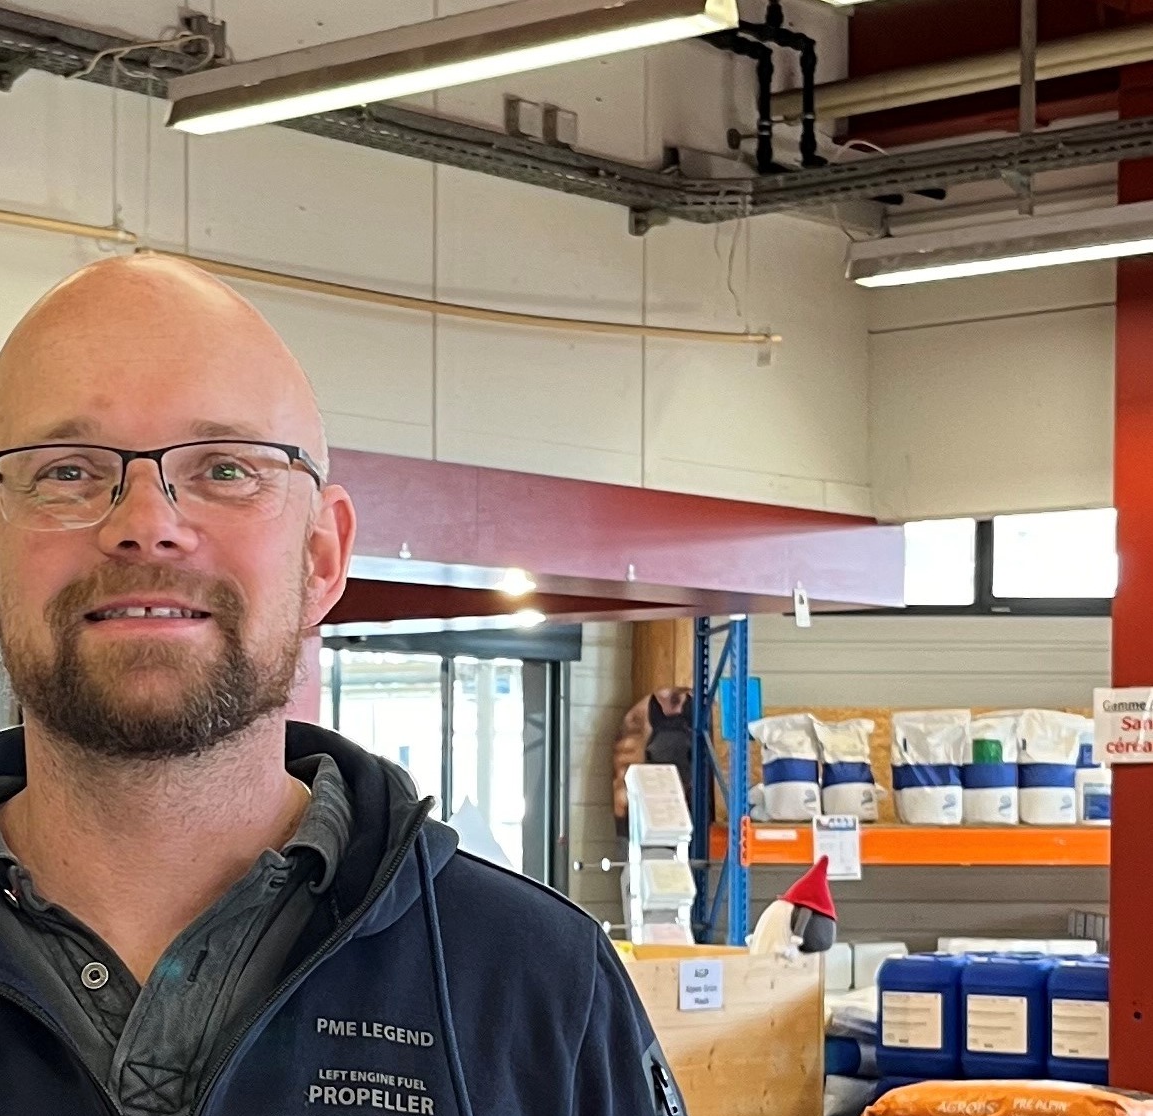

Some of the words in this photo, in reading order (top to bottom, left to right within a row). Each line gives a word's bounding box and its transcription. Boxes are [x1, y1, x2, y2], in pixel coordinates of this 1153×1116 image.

[1103, 700, 1146, 712] Gamme
[316, 1018, 357, 1037] PME
[362, 1022, 434, 1047] LEGEND
[319, 1069, 348, 1081] LEFT
[350, 1070, 395, 1087] ENGINE
[397, 1077, 427, 1091] FUEL
[309, 1085, 434, 1116] PROPELLER
